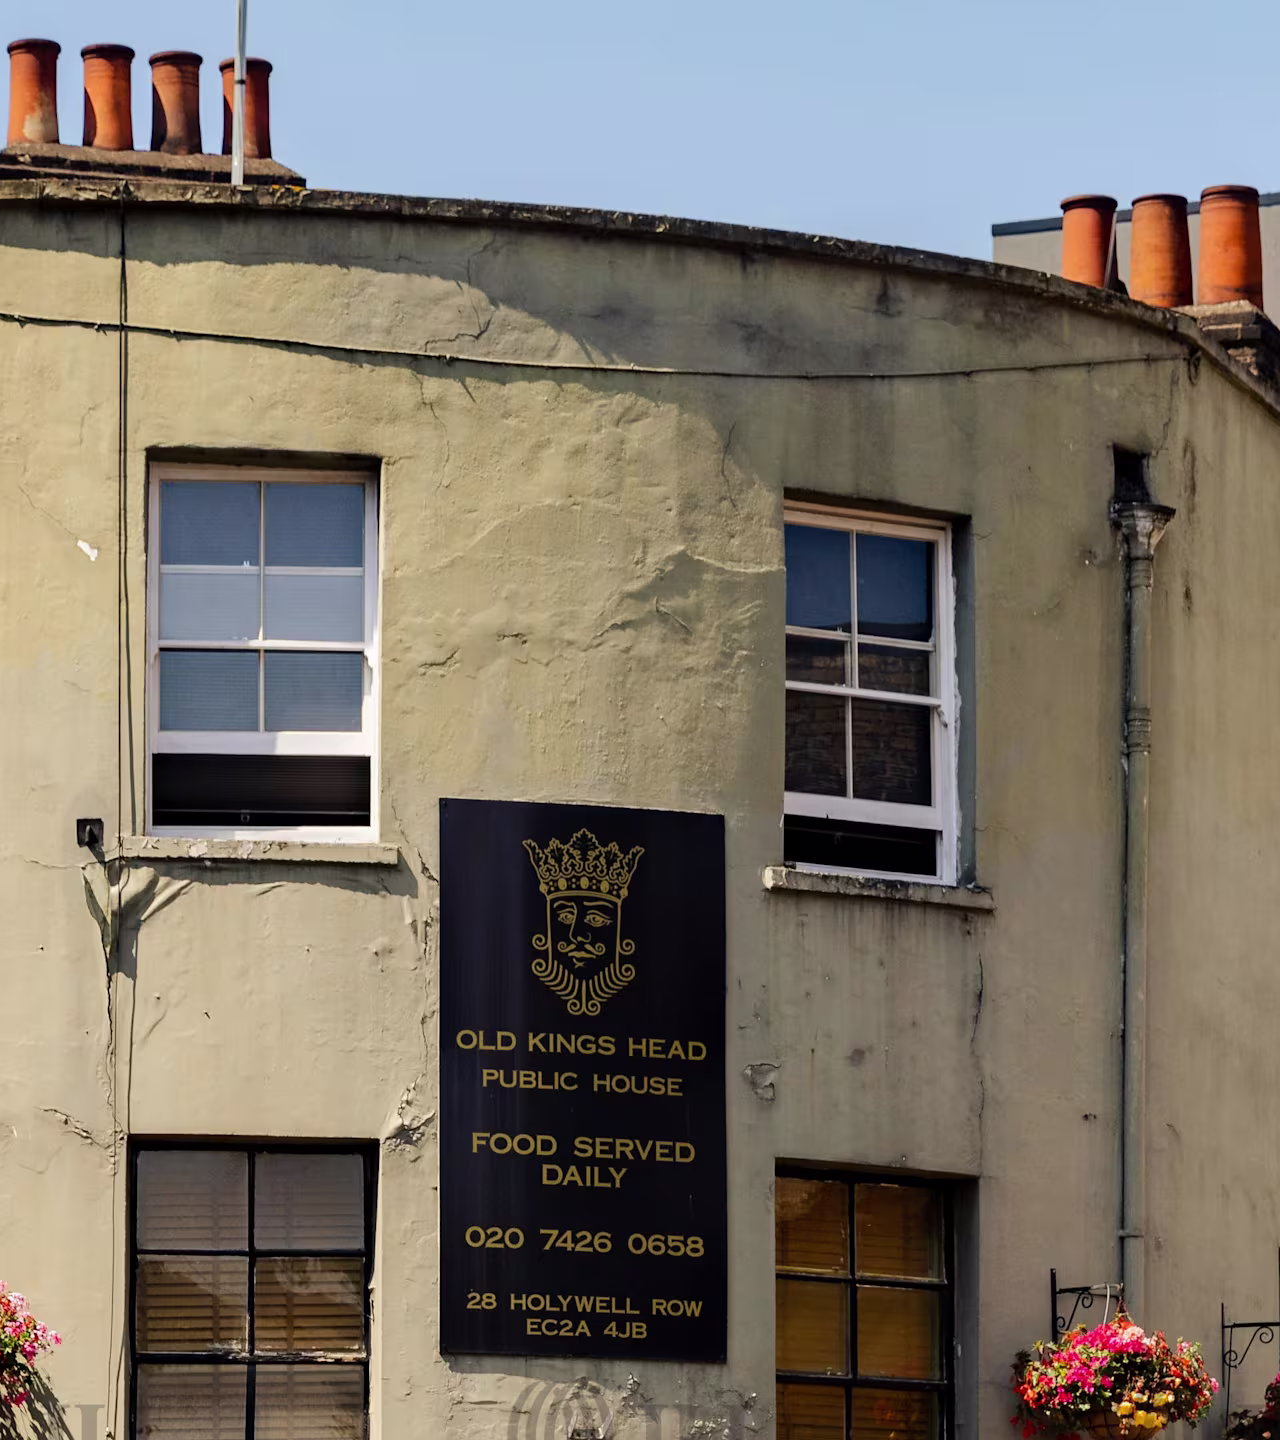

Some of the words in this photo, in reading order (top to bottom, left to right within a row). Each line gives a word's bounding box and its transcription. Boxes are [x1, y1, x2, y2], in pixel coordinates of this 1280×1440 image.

[456, 1029, 516, 1049] OLD
[527, 1032, 616, 1054] KINGS
[628, 1038, 707, 1059] HEAD
[482, 1068, 578, 1089] PUBLIC
[592, 1074, 683, 1095] HOUSE
[471, 1132, 557, 1156] FOOD
[573, 1136, 695, 1161] SERVED
[541, 1164, 627, 1187] DAILY
[465, 1226, 525, 1248] 020
[539, 1230, 612, 1252] 7426
[628, 1234, 704, 1256] 0658
[466, 1292, 497, 1308] 28
[510, 1294, 639, 1314] HOLYWELL
[652, 1299, 702, 1316] ROW
[526, 1319, 591, 1335] EC2A
[603, 1321, 647, 1337] 4JB
